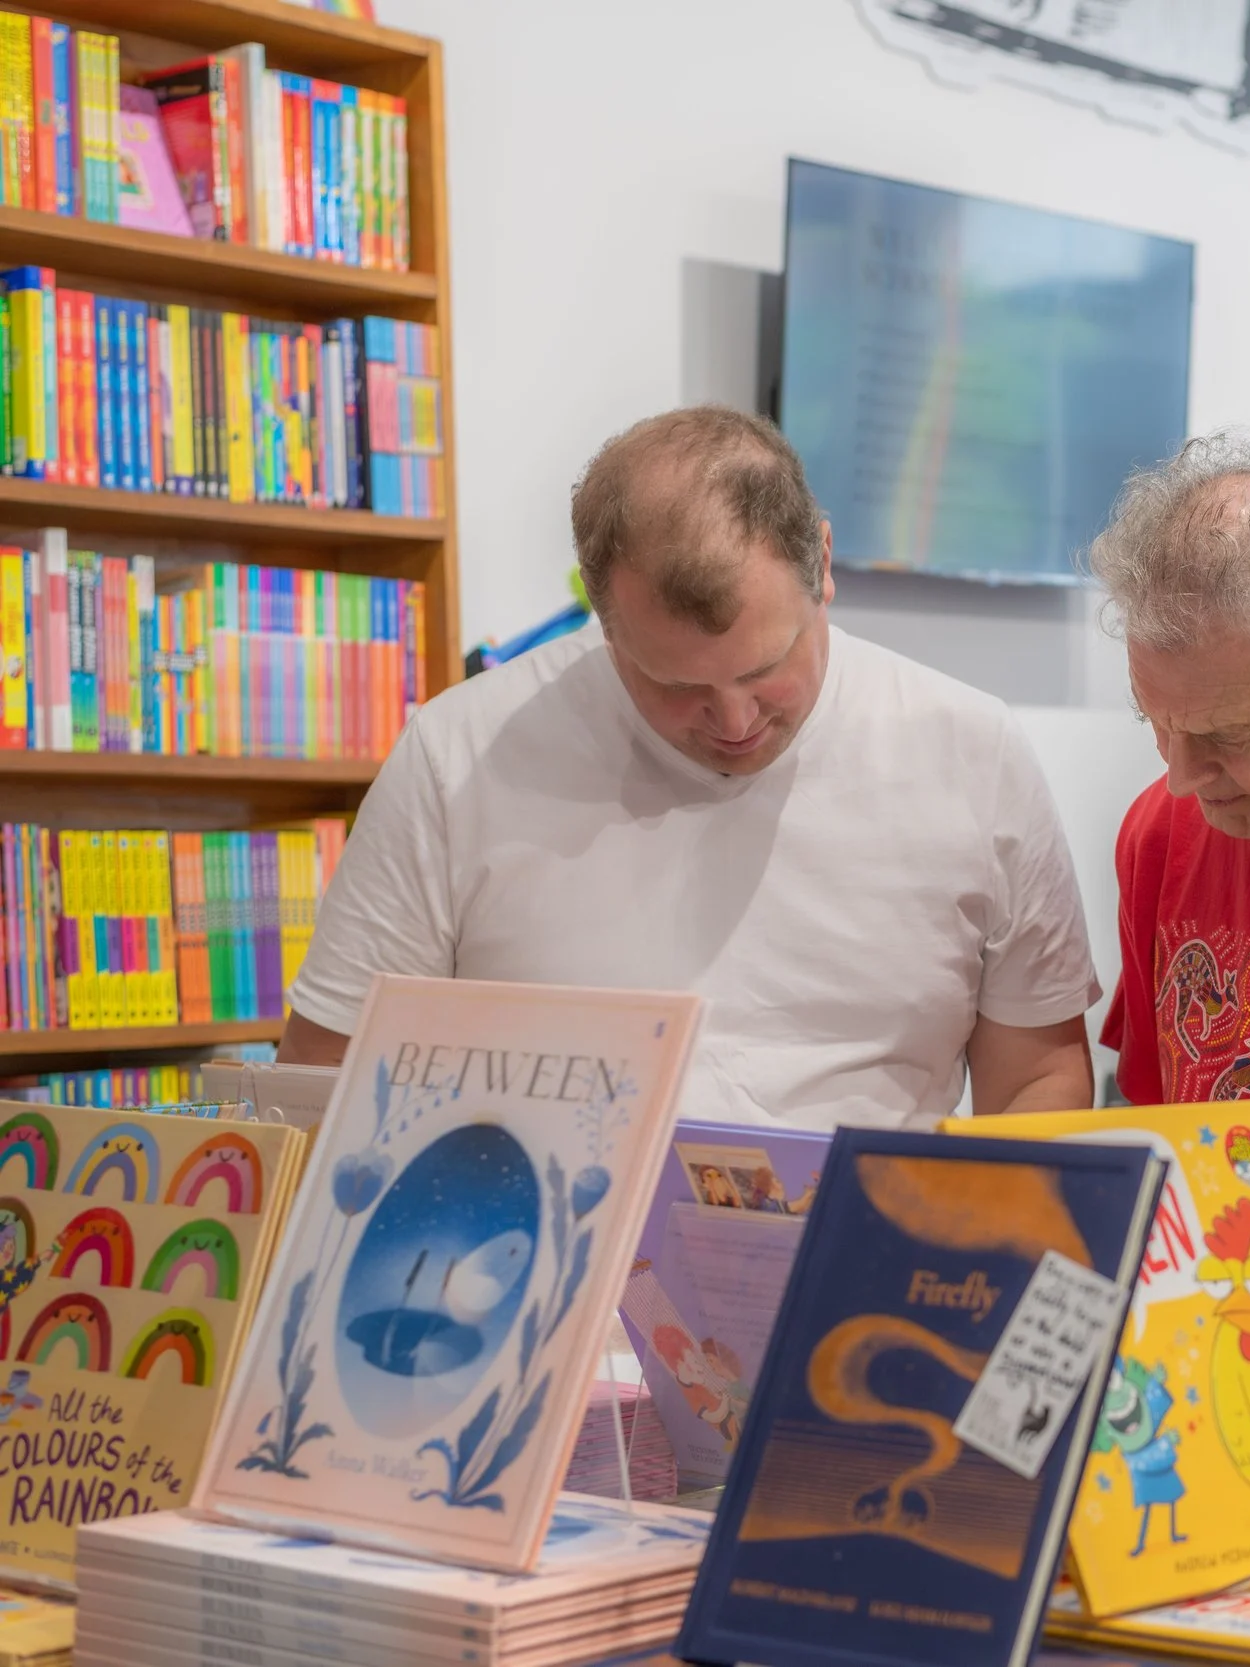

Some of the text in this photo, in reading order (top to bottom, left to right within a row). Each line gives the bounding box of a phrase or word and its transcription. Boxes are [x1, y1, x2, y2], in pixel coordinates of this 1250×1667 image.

[388, 1040, 629, 1103] BETWEEN
[906, 1269, 1001, 1322] Firefly
[48, 1386, 123, 1425] All the
[126, 1444, 151, 1480] of
[151, 1456, 184, 1494] the
[9, 1474, 159, 1527] RAINBO
